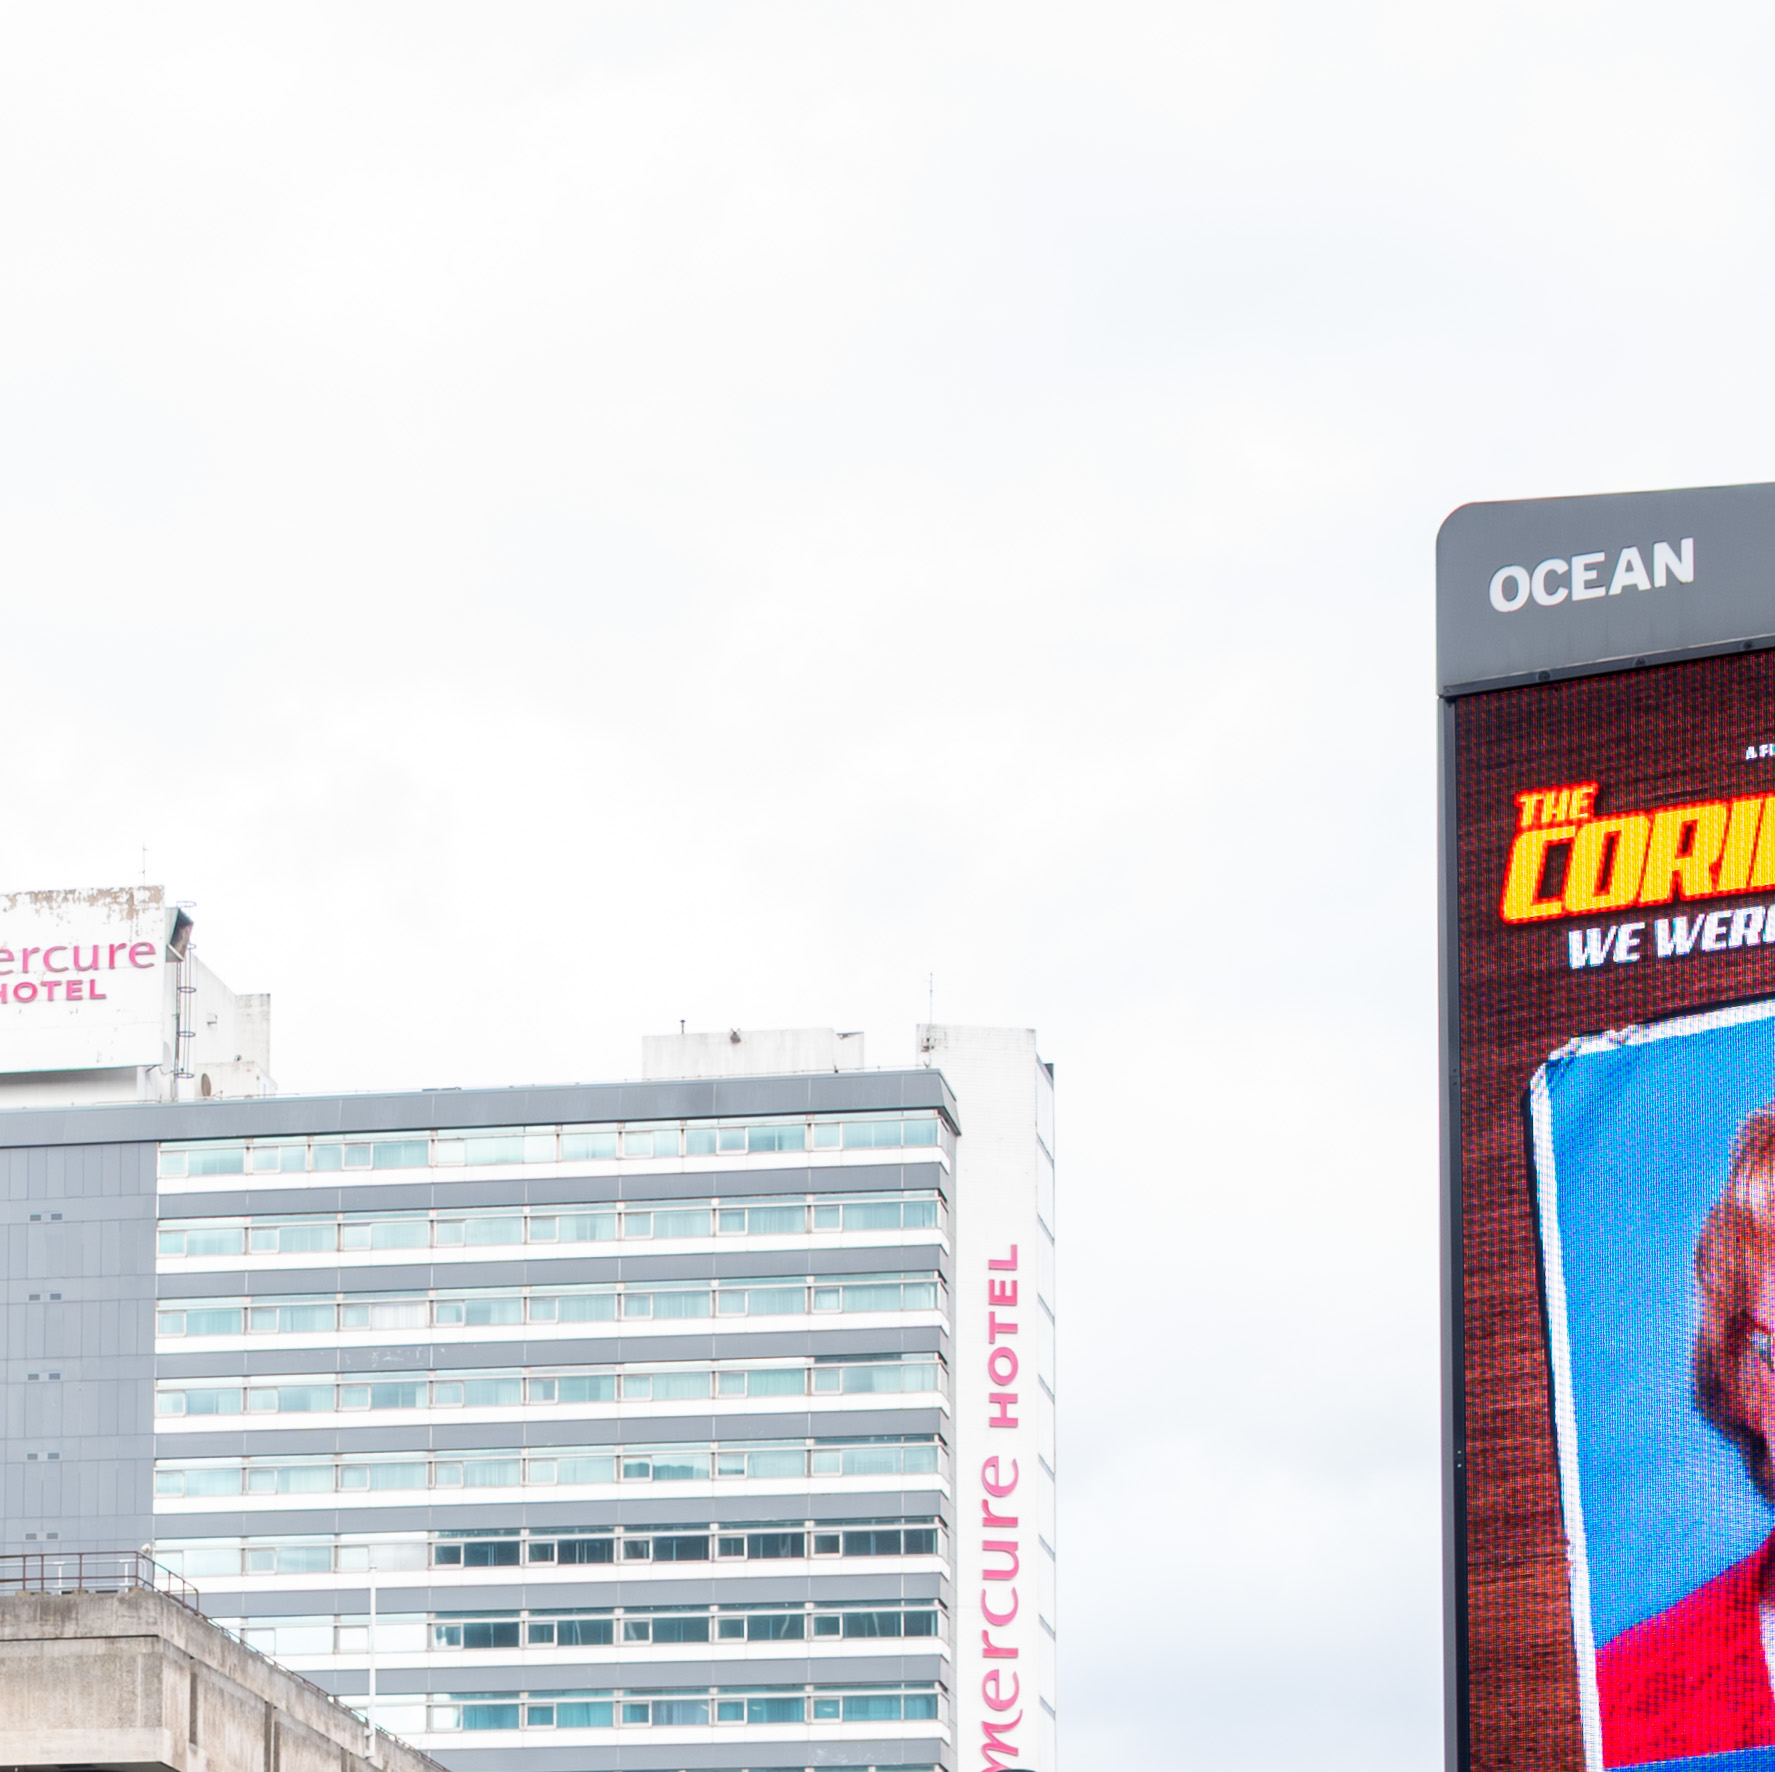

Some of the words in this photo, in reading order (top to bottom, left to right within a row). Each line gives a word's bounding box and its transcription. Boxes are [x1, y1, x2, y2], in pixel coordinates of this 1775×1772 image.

[1489, 537, 1695, 613] OCEAN
[1746, 746, 1758, 760] A
[1514, 780, 1598, 830] THE
[1568, 919, 1641, 969] WE
[988, 1244, 1019, 1428] HOTEL
